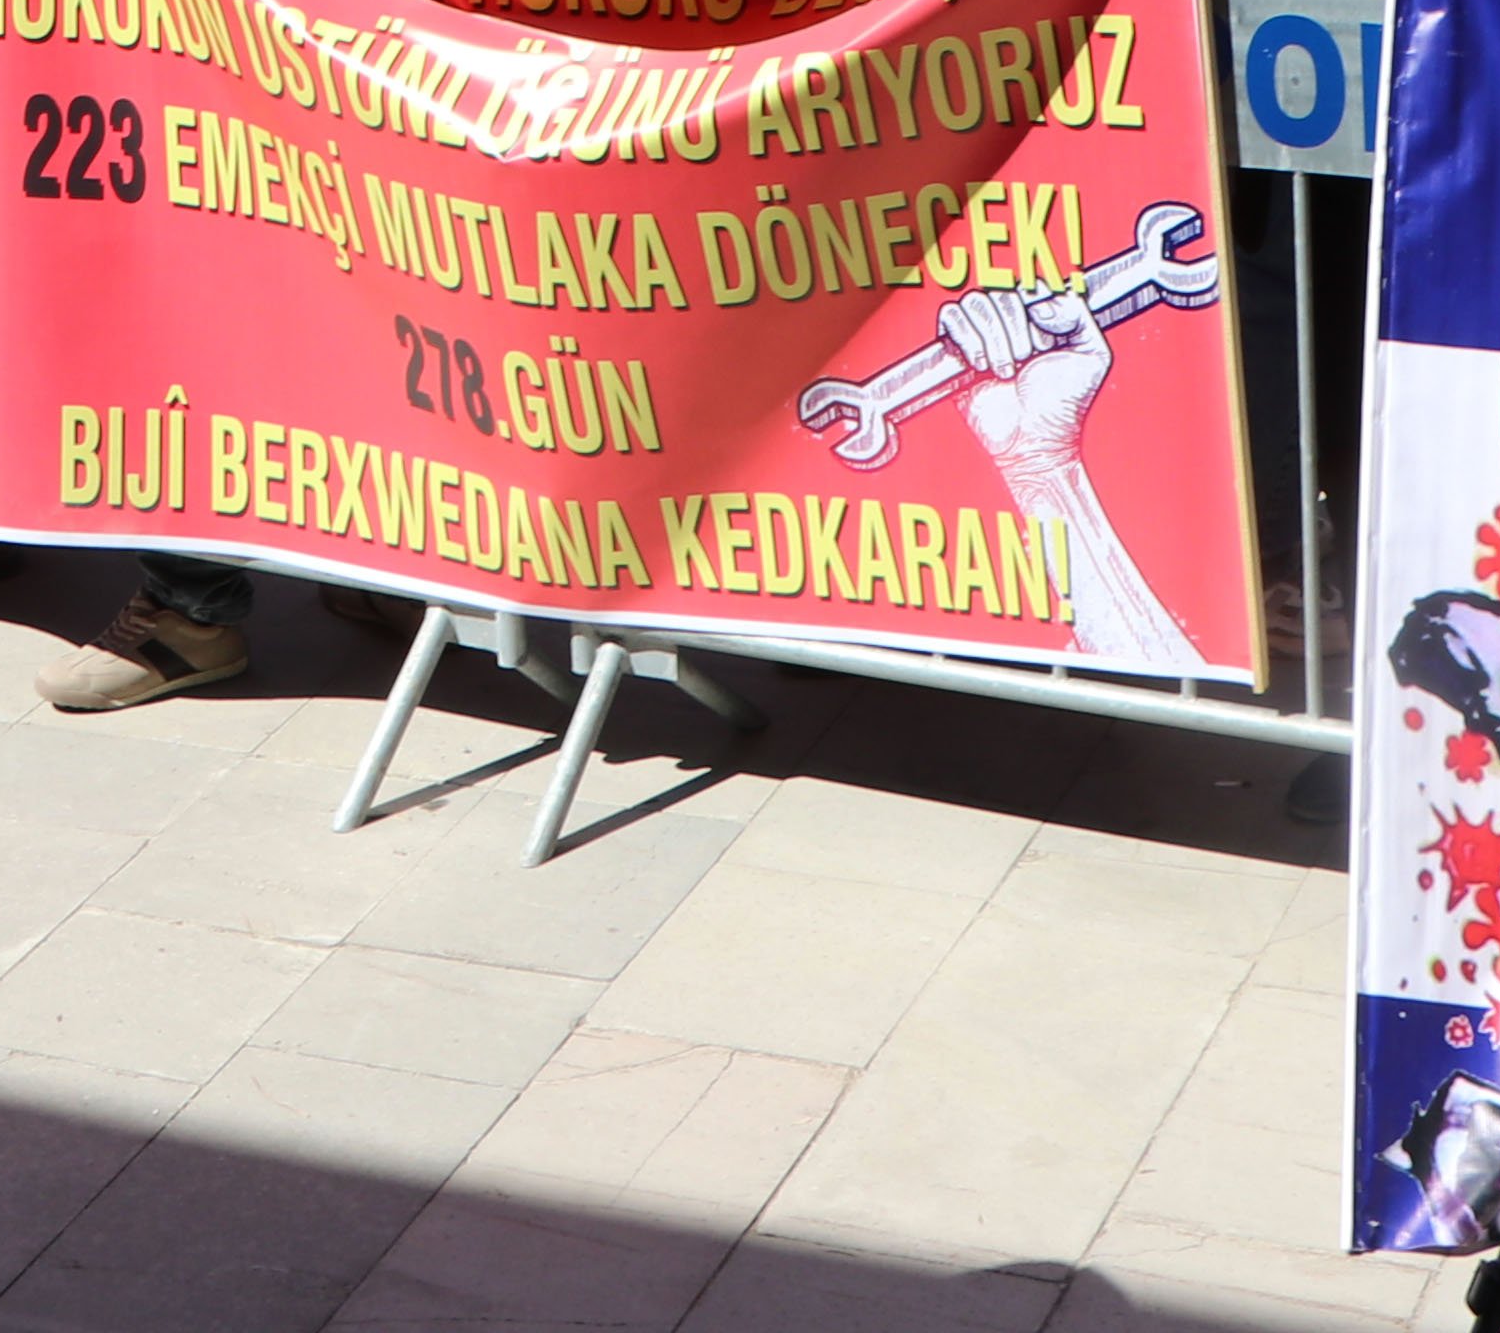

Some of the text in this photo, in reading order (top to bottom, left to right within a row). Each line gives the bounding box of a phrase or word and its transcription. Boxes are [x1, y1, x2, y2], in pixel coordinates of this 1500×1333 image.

[746, 13, 1146, 160] ARIYORUZ
[22, 93, 1087, 312] 223 EMEKÇİ MUTLAKA DÖNECEK!
[59, 383, 1078, 626] BIJÎ BERXWEDANA KEDKARAN!
